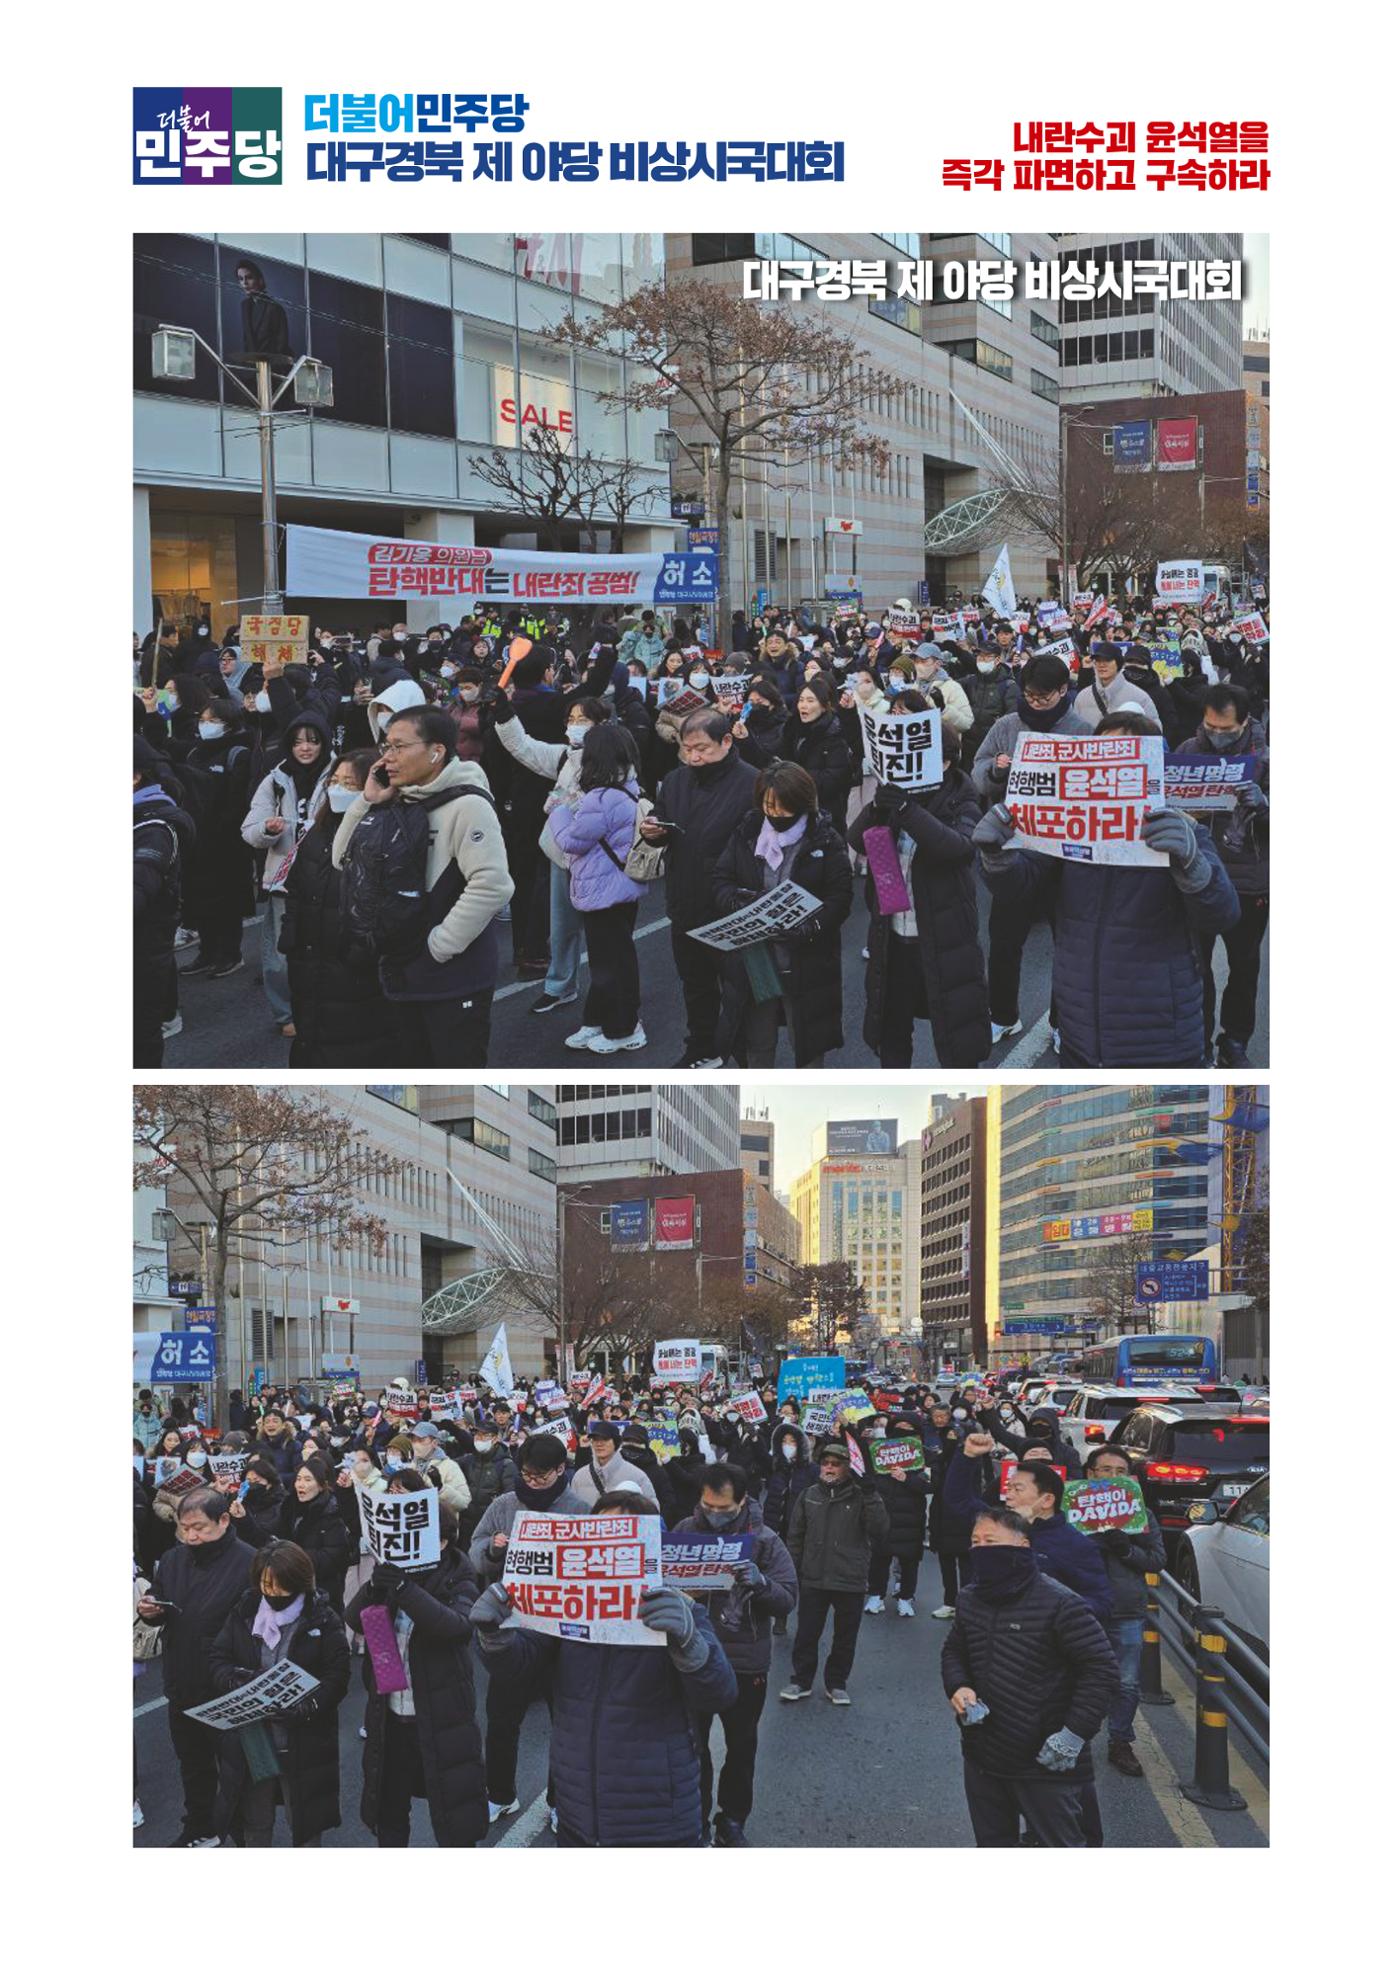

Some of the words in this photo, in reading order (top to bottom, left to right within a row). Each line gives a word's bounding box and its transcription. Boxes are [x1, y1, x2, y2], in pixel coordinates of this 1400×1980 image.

[500, 399, 573, 433] SALE
[368, 567, 509, 597] 탄핵반대는
[513, 572, 584, 598] 내란죄
[587, 571, 640, 595] 공범!
[864, 712, 932, 753] 윤석열
[871, 745, 922, 782] 퇴진!
[1058, 740, 1136, 761] 군사반란죄
[1008, 771, 1056, 797] 현행범
[875, 1449, 921, 1466] DAVIDA
[1078, 1488, 1126, 1507] 탄핵이
[361, 1492, 430, 1531] 윤석열
[1068, 1499, 1141, 1523] DAVIDA
[368, 1524, 420, 1561] 퇴진!
[555, 1519, 633, 1540] 군사반란죄
[506, 1550, 553, 1576] 현행범
